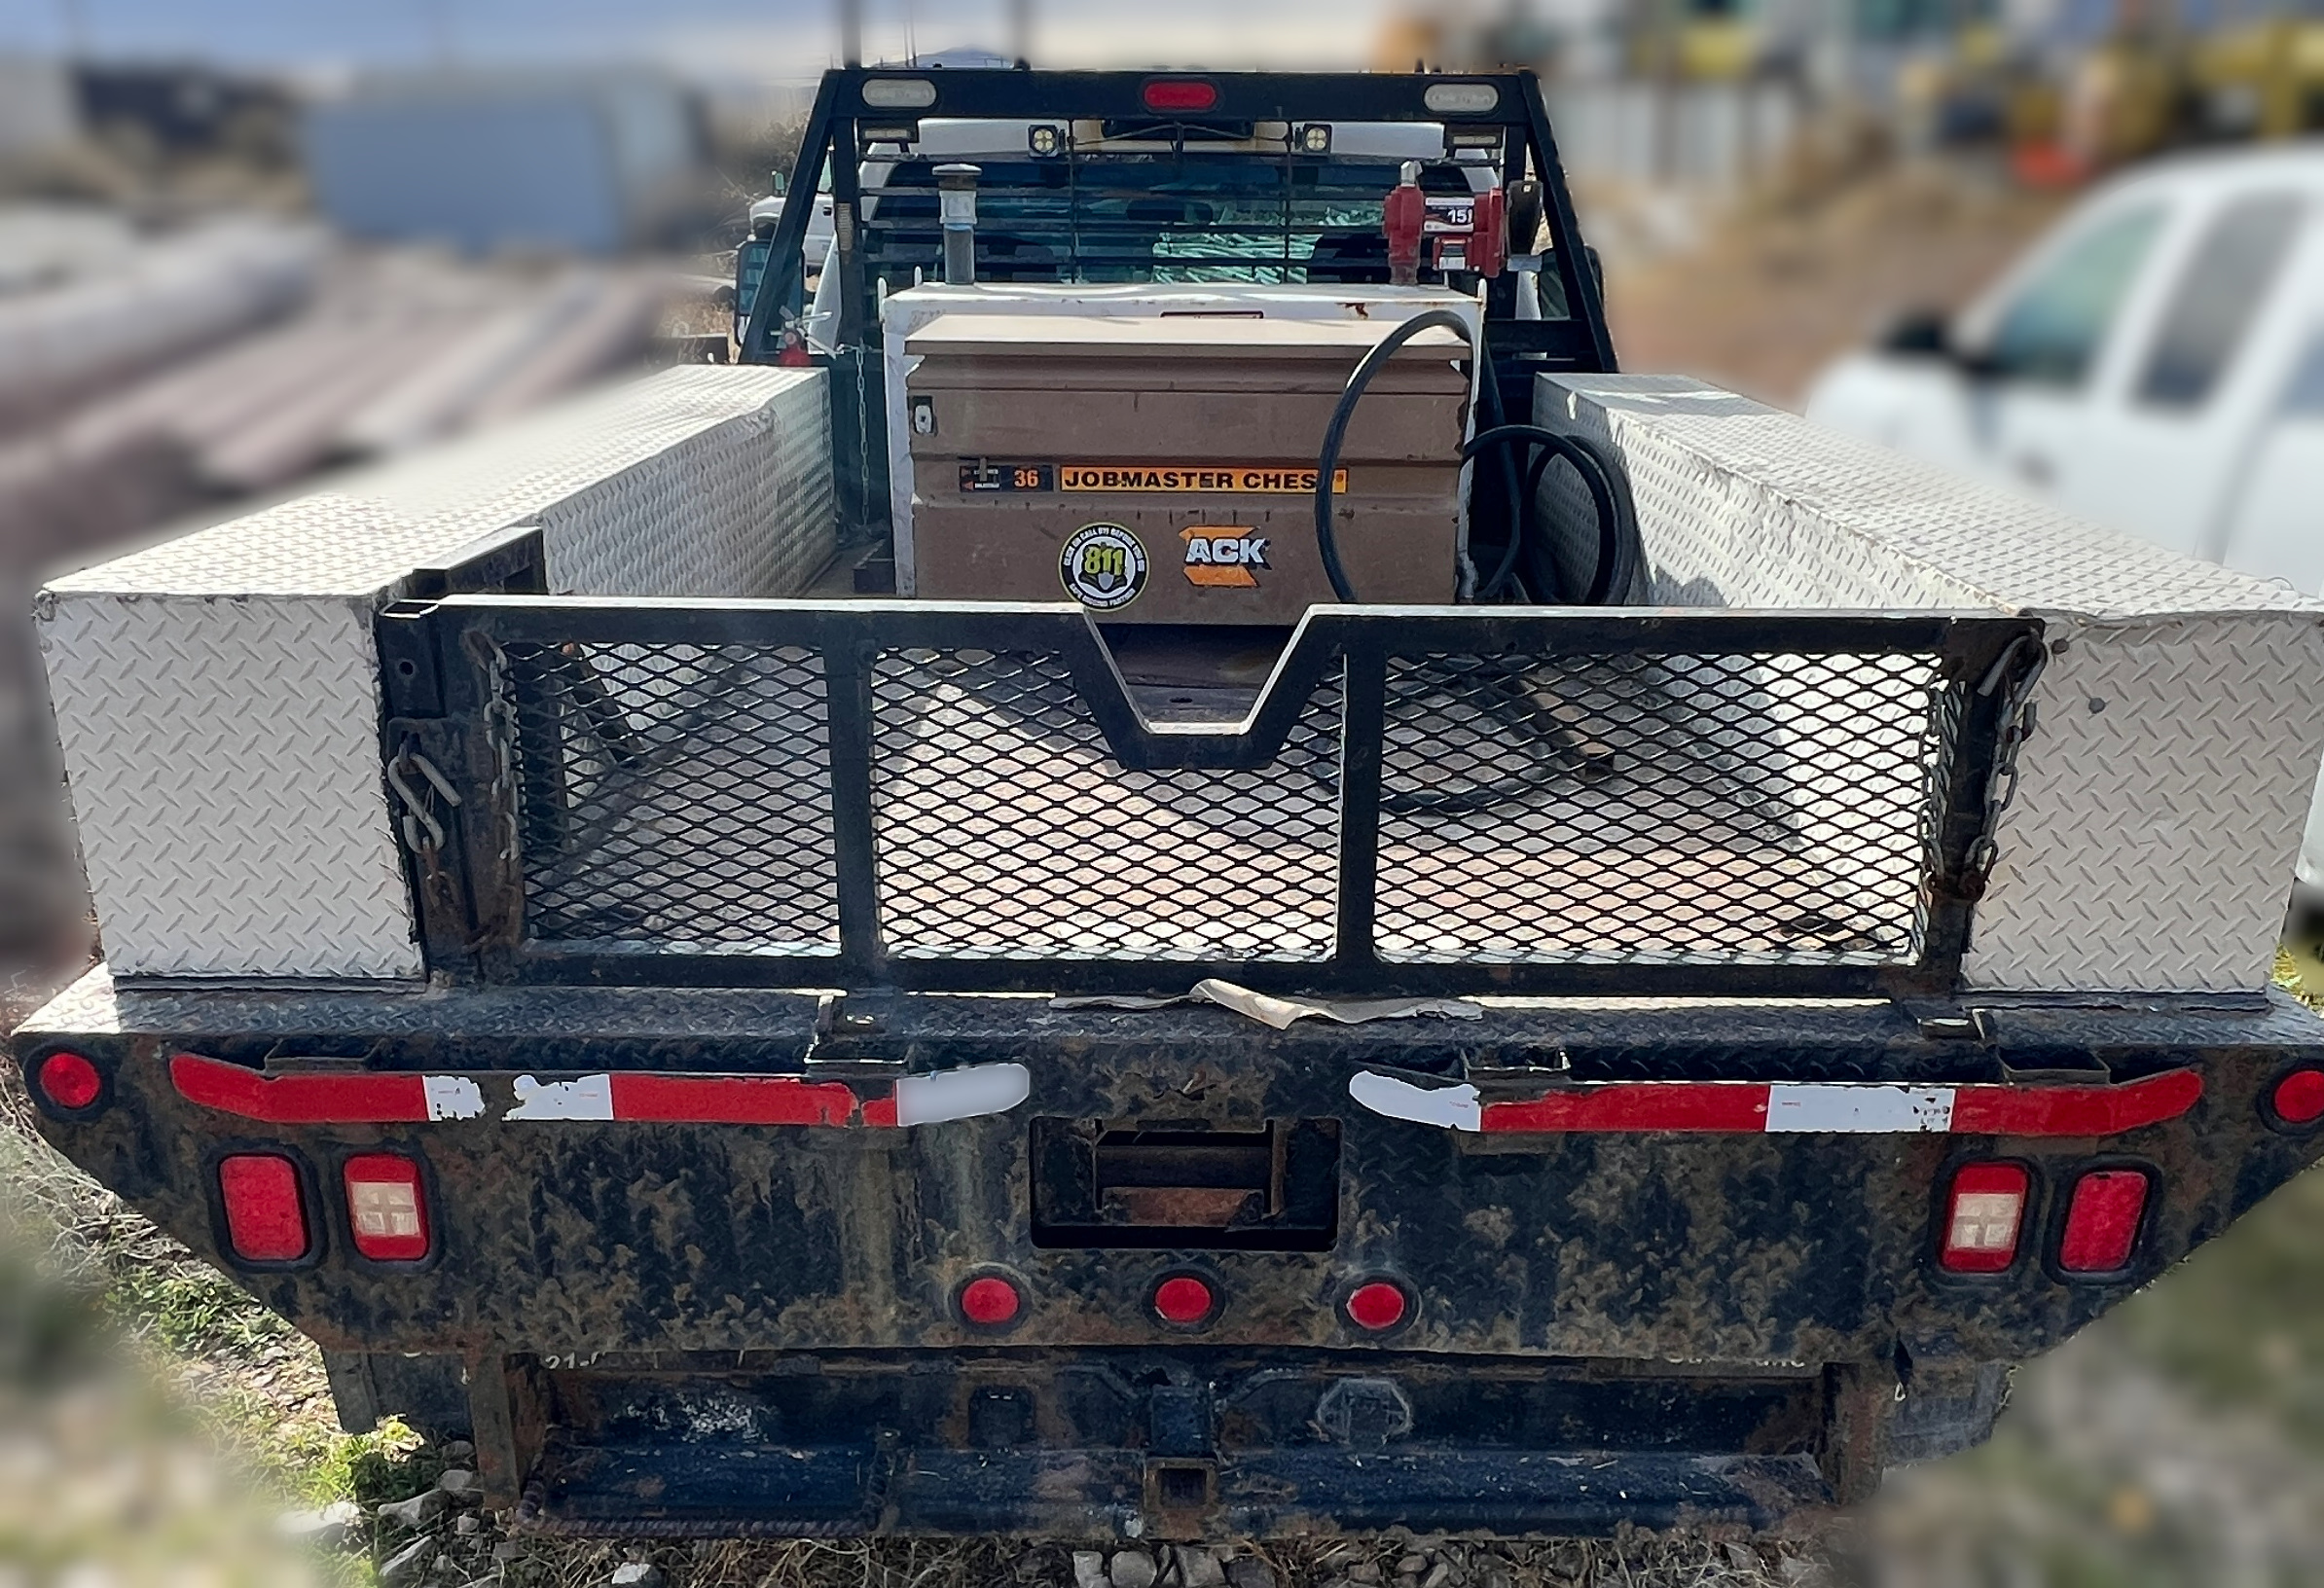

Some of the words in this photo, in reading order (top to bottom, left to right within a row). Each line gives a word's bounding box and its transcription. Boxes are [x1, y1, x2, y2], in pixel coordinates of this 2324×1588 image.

[1014, 469, 1039, 487] 36
[1065, 471, 1234, 488] JOBMASTER
[1243, 472, 1318, 489] CHES
[1084, 545, 1124, 576] 811
[1184, 538, 1266, 563] ACK
